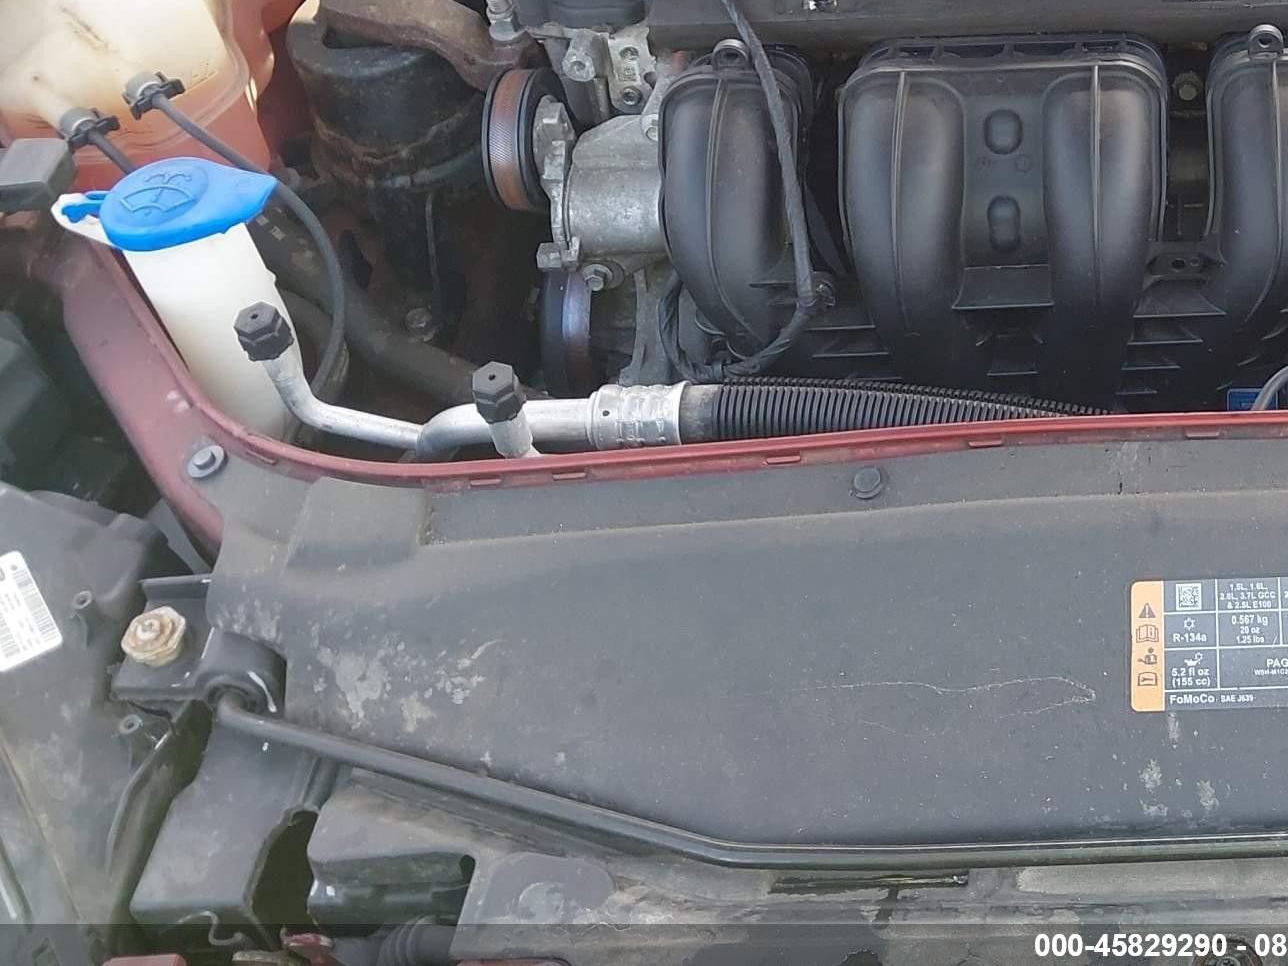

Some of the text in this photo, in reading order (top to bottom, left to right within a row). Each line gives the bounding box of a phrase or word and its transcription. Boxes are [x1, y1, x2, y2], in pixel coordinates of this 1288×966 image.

[1239, 591, 1257, 600] 3.7L
[1253, 600, 1271, 608] E100
[1231, 614, 1268, 626] 0.567 kg
[1240, 626, 1249, 634] 20
[1173, 632, 1207, 642] R-134a
[1253, 635, 1265, 643] lbs
[1266, 658, 1288, 668] PAG
[1172, 667, 1210, 677] 5.2 fl oz
[1172, 677, 1211, 687] (155 cc)
[1170, 693, 1215, 704] FoMoCo
[1220, 694, 1254, 702] SAE J639
